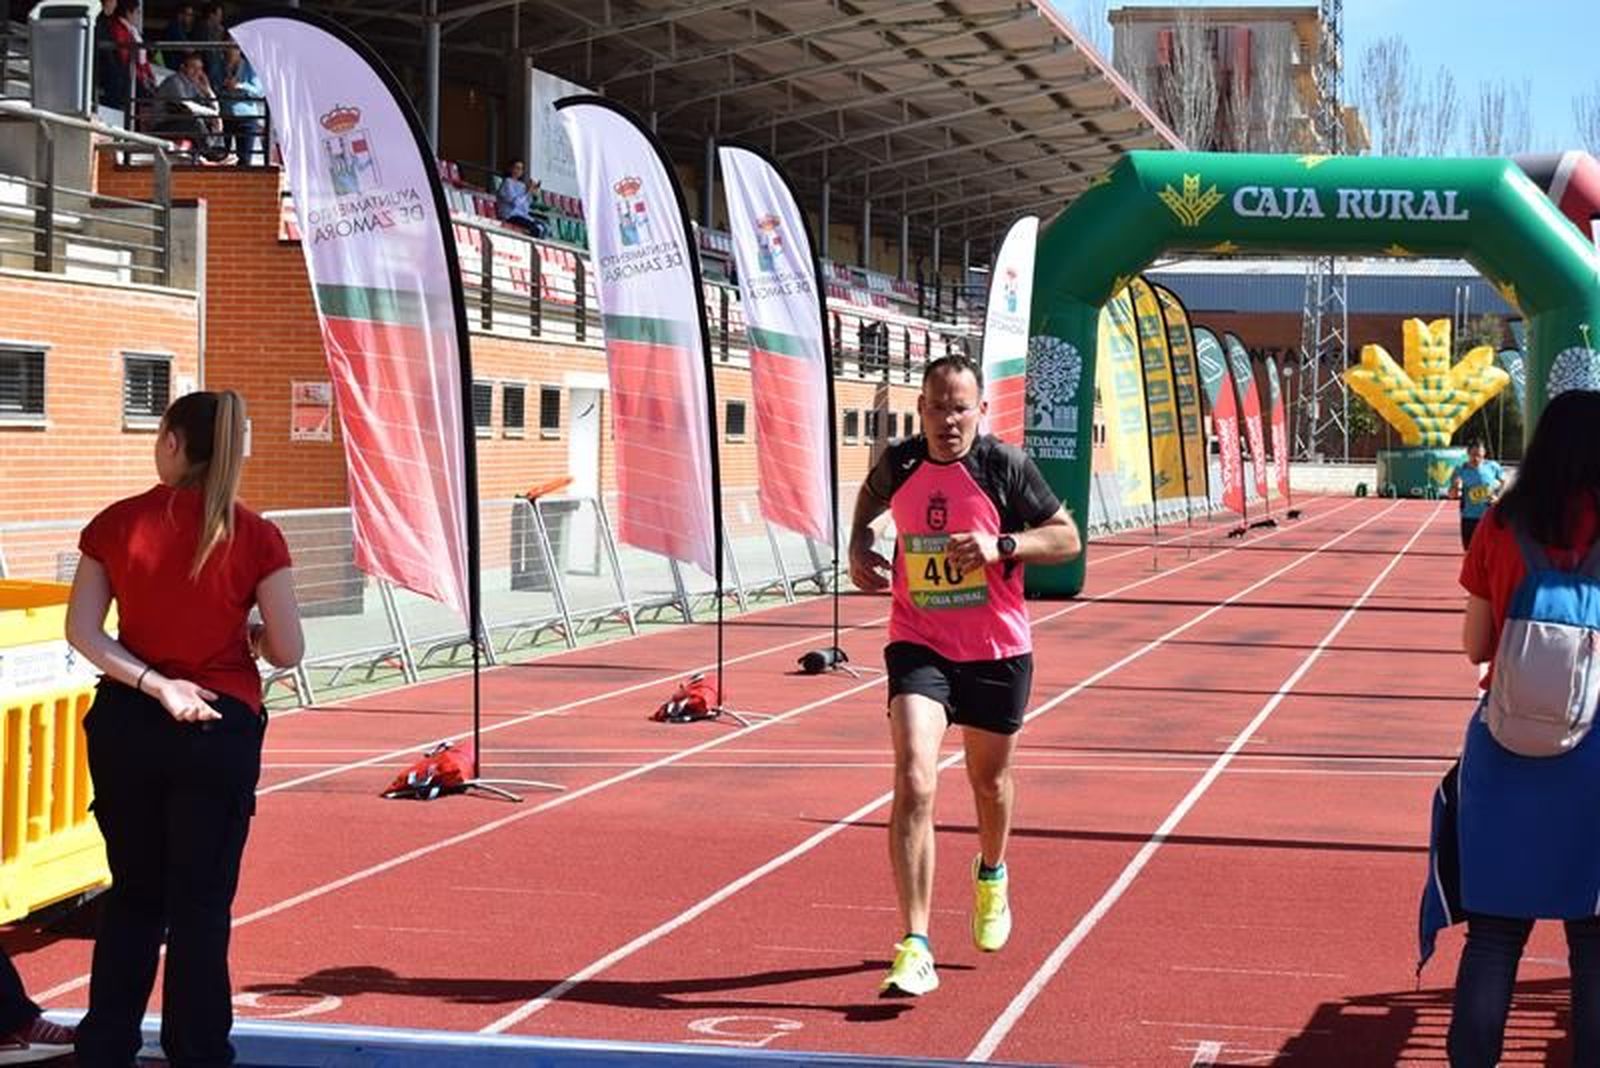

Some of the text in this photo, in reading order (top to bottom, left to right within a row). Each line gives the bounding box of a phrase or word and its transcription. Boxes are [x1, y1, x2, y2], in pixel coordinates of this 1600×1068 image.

[1233, 186, 1469, 221] CAJA RURAL
[1024, 436, 1077, 448] NDACION
[1039, 448, 1077, 460] RURAL
